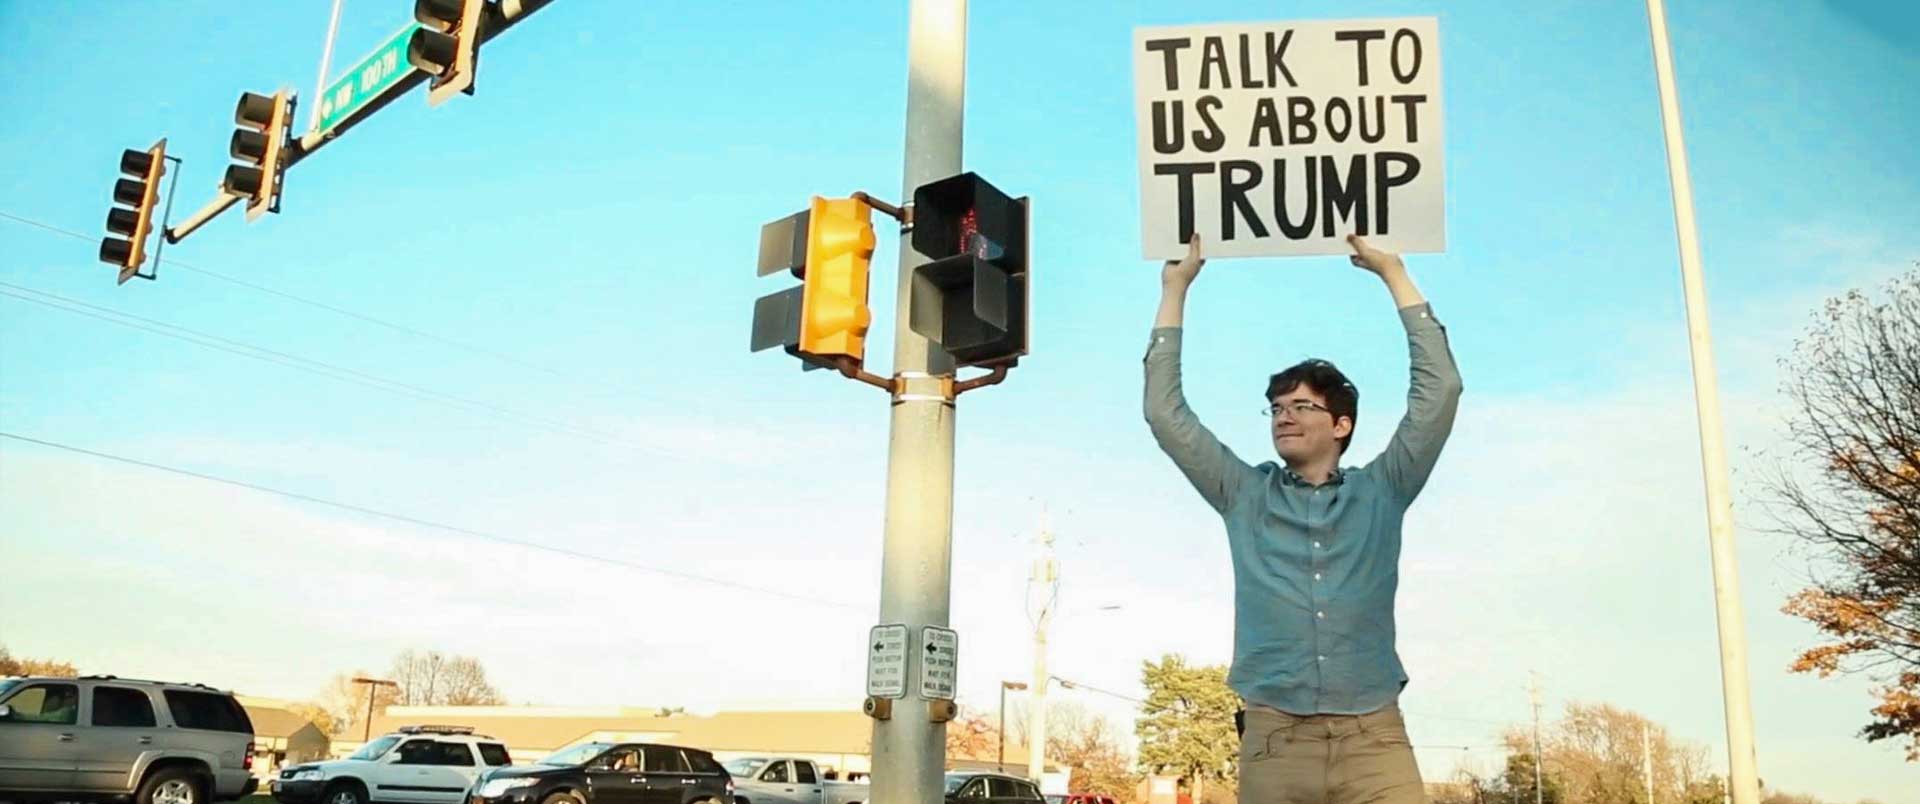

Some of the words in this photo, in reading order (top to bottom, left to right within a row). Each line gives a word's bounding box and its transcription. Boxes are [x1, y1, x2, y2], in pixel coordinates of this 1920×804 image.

[1146, 29, 1298, 91] TALK
[1335, 28, 1423, 87] TO
[1151, 95, 1226, 154] US
[1248, 94, 1427, 147] ABOUT
[1154, 151, 1422, 244] TRUMP
